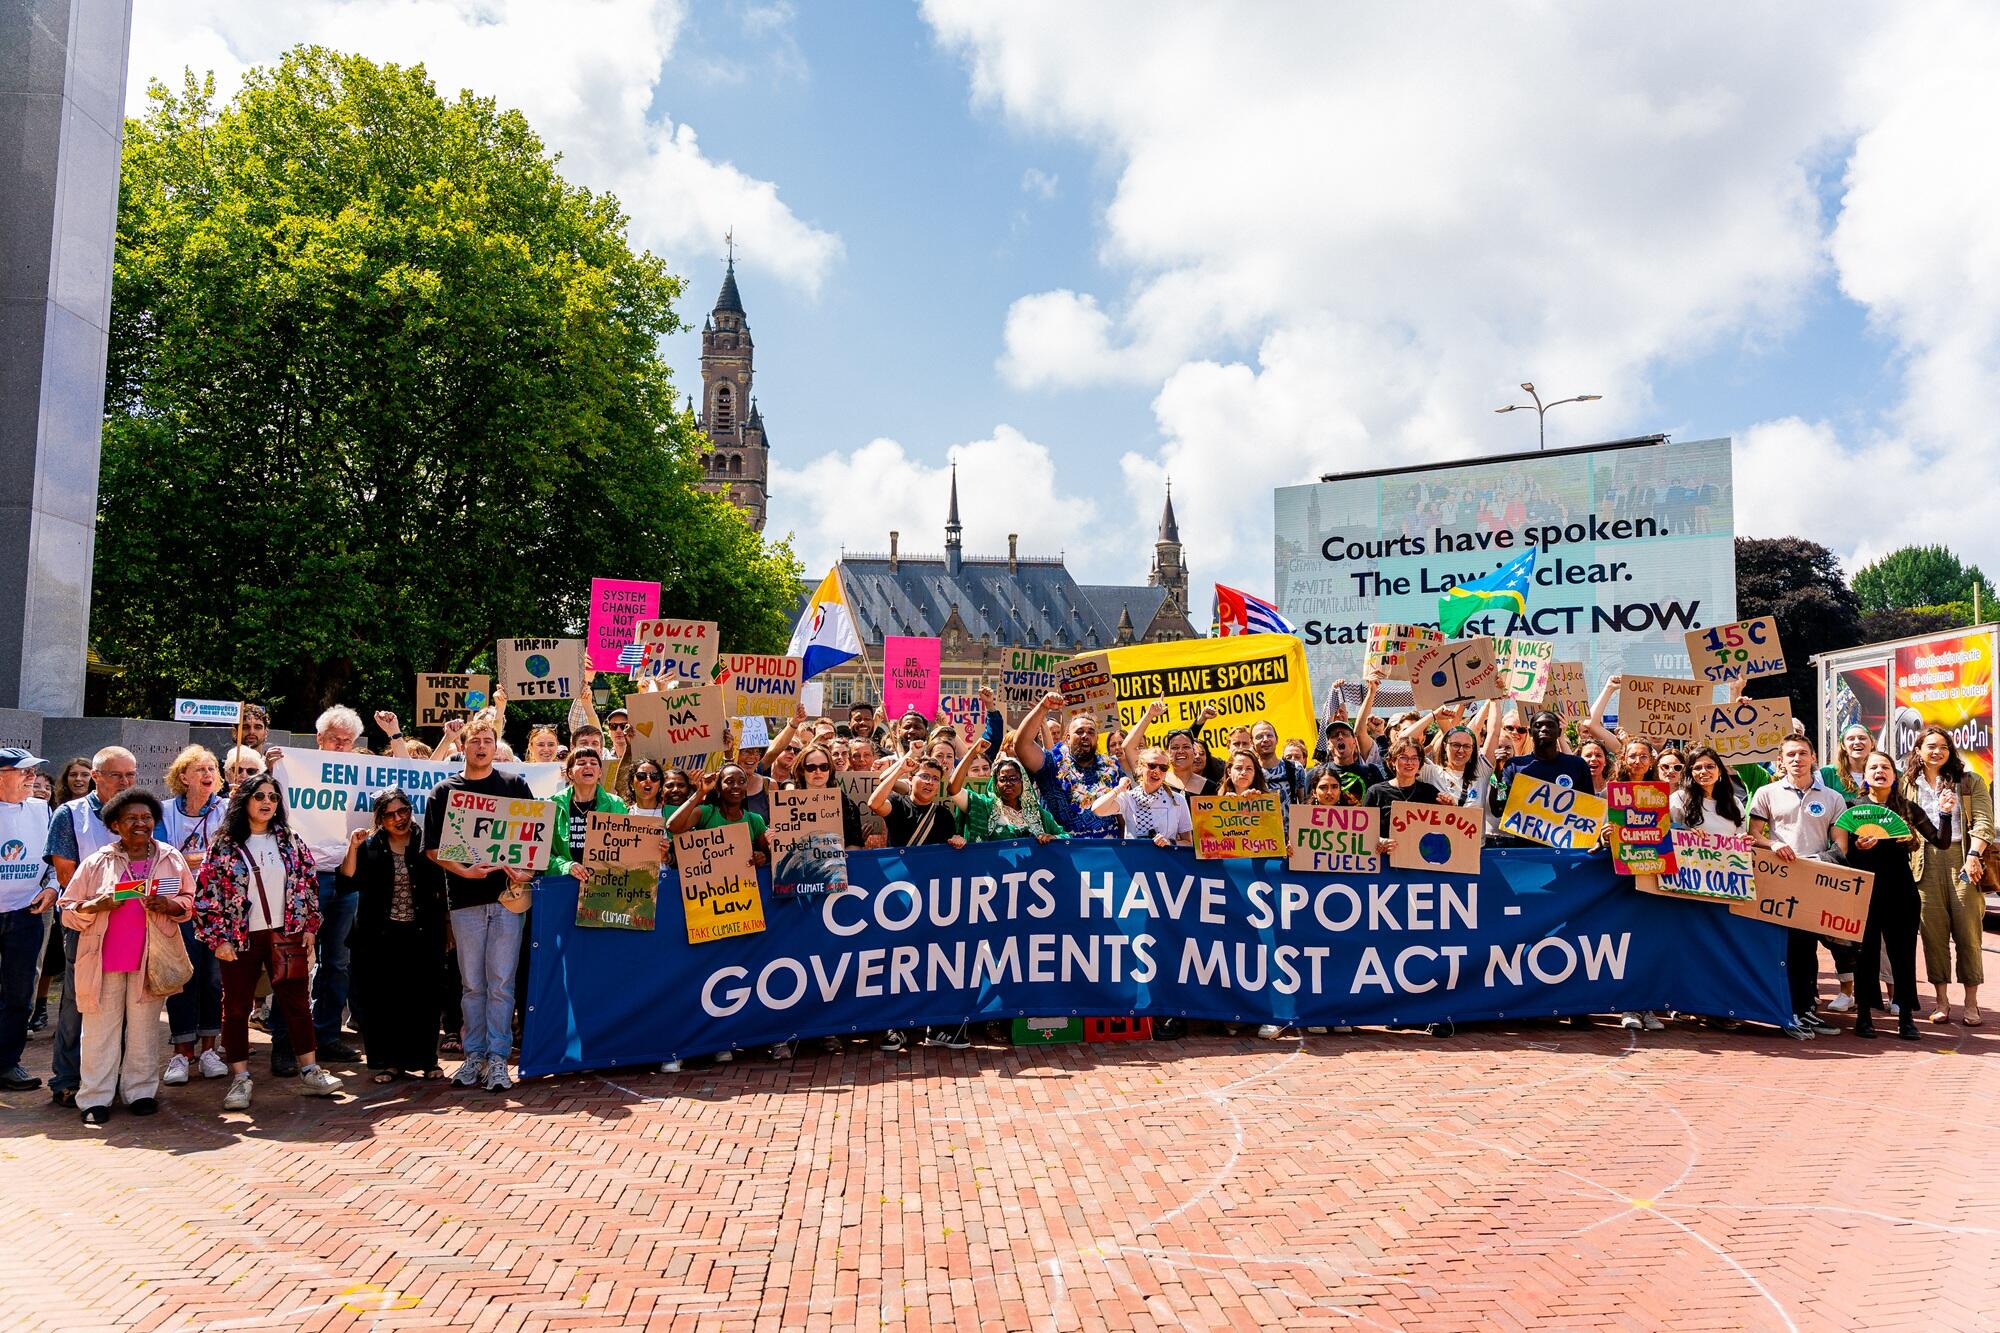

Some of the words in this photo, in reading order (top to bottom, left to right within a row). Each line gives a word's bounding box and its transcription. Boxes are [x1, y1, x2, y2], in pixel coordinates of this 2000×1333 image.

[1322, 535, 1426, 561] Courts
[1436, 527, 1514, 553] have
[1524, 512, 1669, 554] spoken.
[1351, 571, 1411, 598] The
[1421, 568, 1487, 594] Law
[1535, 558, 1633, 586] clear.
[603, 590, 647, 602] SYSTEM
[602, 602, 647, 614] CHANGE
[612, 616, 635, 625] NOT
[1304, 619, 1369, 646] Stat
[1504, 605, 1584, 637] ACT
[1592, 600, 1701, 633] NOW.
[599, 626, 637, 638] CLIMAT
[640, 622, 706, 640] POWER
[514, 639, 559, 652] HARIAP
[671, 643, 699, 656] THE
[905, 657, 918, 667] DE
[1011, 650, 1070, 673] CLIMA
[1513, 658, 1537, 671] the
[1715, 649, 1749, 664] TO
[730, 656, 797, 678] UPHOLD
[891, 667, 931, 678] KLIMAAT
[1411, 647, 1440, 685] CLIMATE
[1704, 664, 1742, 682] STAY
[426, 676, 470, 689] THERE
[895, 679, 904, 689] IS
[906, 679, 926, 689] VOL!
[1003, 671, 1056, 688] JUSTICE
[1168, 669, 1212, 693] HAVE
[1217, 658, 1286, 688] SPOKEN
[1465, 664, 1495, 689] JUSTICE!
[735, 676, 796, 695] HUMAN
[1004, 686, 1033, 702] YUMI
[1629, 679, 1654, 693] OUR
[1663, 682, 1705, 696] PLANET
[435, 692, 450, 708] IS
[661, 692, 702, 711] YUMI
[736, 695, 797, 717] RIGHTS
[941, 695, 990, 713] CLIMAT
[1637, 697, 1692, 713] DEPENDS
[668, 709, 698, 727] NA
[945, 711, 987, 726] JUSTI
[1648, 713, 1661, 721] ON
[1664, 713, 1676, 721] THE
[1710, 704, 1758, 733] AO
[667, 724, 711, 744] YUMI
[1756, 727, 1787, 746] GO!
[321, 763, 359, 785] EEN
[366, 766, 458, 790] LEEFBAR
[288, 787, 348, 811] VOOR
[451, 793, 498, 813] SAVE
[508, 800, 547, 817] OUR
[774, 791, 808, 807] Law
[812, 794, 820, 802] of
[1198, 802, 1214, 811] NO
[1219, 799, 1276, 812] CLIMATE
[1528, 784, 1576, 814] AO
[790, 808, 817, 822] Sea
[1212, 815, 1261, 828] JUSTICE
[1311, 807, 1369, 832] END
[1392, 808, 1441, 833] SAVE
[1444, 812, 1478, 840] OUR
[1564, 813, 1597, 834] FOR
[473, 817, 546, 843] FUTUR
[591, 815, 664, 836] InterAmerican
[775, 821, 801, 832] said
[1222, 829, 1251, 837] WITHOUT
[1504, 811, 1572, 849] AFRICA
[603, 832, 641, 848] Court
[679, 829, 725, 850] World
[773, 835, 814, 853] Protect
[822, 837, 838, 846] the
[1621, 828, 1661, 842] CLIMATE
[1672, 831, 1711, 848] LIMATE
[702, 843, 735, 861] Court
[1201, 838, 1236, 853] HUMAN
[1242, 838, 1278, 853] RIGHTS
[1697, 847, 1723, 862] the
[0, 864, 39, 873] OTOUDERS
[685, 860, 712, 878] said
[1313, 852, 1377, 872] FUELS
[15, 872, 38, 880] KLIMAAT
[584, 866, 630, 886] Protect
[1661, 866, 1702, 891] WORLD
[1705, 870, 1754, 896] COURT
[1815, 873, 1866, 896] must
[583, 888, 610, 898] Human
[616, 888, 652, 903] Rights
[685, 874, 740, 907] Uphold
[743, 879, 757, 888] the
[797, 882, 825, 894] CLIMATE
[713, 899, 753, 915] Law
[823, 870, 1056, 936] COURTS
[1081, 872, 1226, 926] HAVE
[1246, 881, 1478, 932] SPOKEN
[601, 910, 631, 925] CLIMATE
[1760, 896, 1800, 919] act
[1820, 910, 1861, 935] now
[689, 927, 710, 940] TAKE
[712, 921, 741, 937] CLIMATE
[742, 920, 765, 932] ACTION
[702, 934, 1157, 1017] GOVERNMENTS
[1178, 938, 1330, 995] MUST
[1350, 945, 1468, 994] ACT
[1485, 933, 1631, 987] NOW
